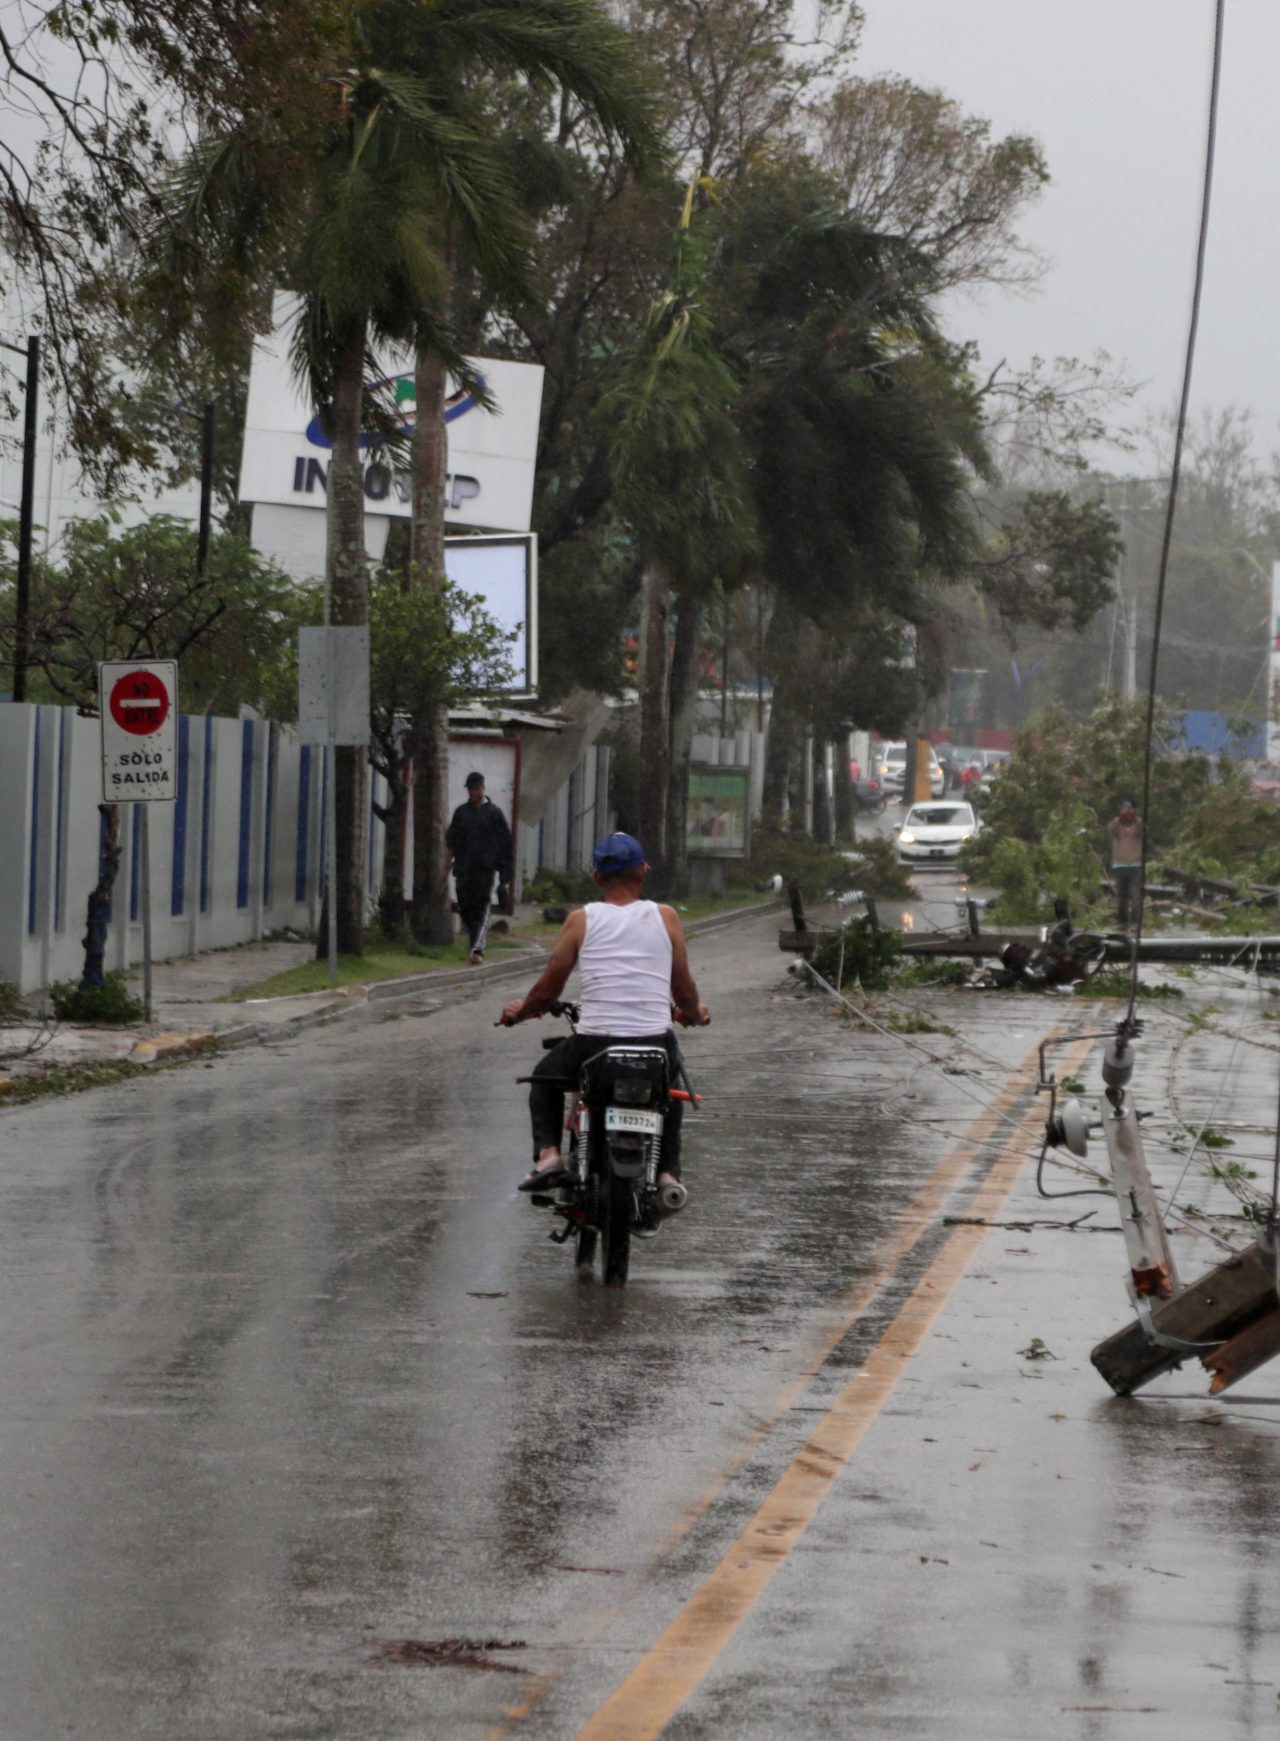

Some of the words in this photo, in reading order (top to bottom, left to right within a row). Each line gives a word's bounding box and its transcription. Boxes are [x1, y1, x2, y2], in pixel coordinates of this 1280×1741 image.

[133, 681, 150, 698] NO
[124, 708, 161, 724] ENTRE
[112, 770, 170, 784] SALIDA
